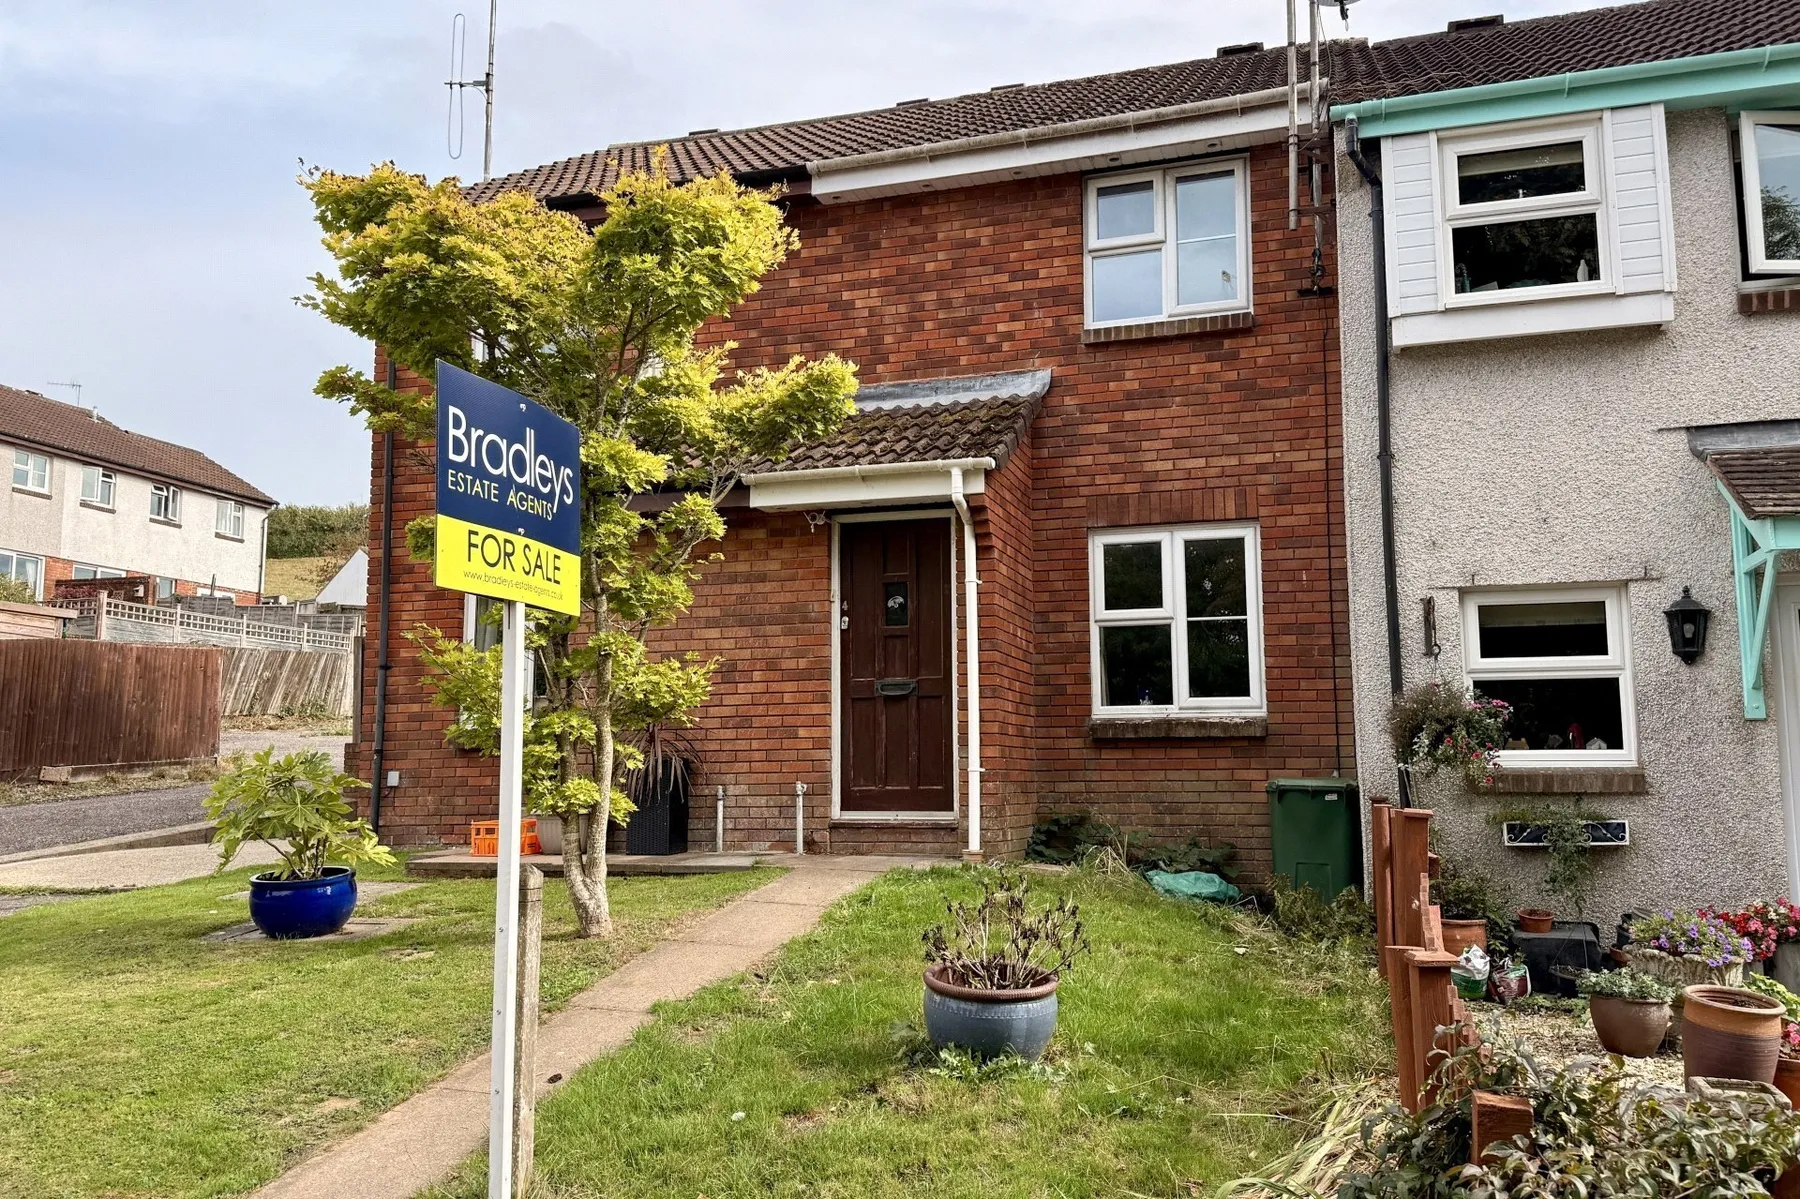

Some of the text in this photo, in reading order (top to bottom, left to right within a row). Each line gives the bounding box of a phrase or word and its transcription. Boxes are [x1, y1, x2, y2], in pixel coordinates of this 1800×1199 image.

[448, 405, 573, 514] Bradleys
[448, 469, 553, 521] ESTATE AGENTS
[467, 529, 561, 585] FOR SALE
[841, 600, 849, 611] 4
